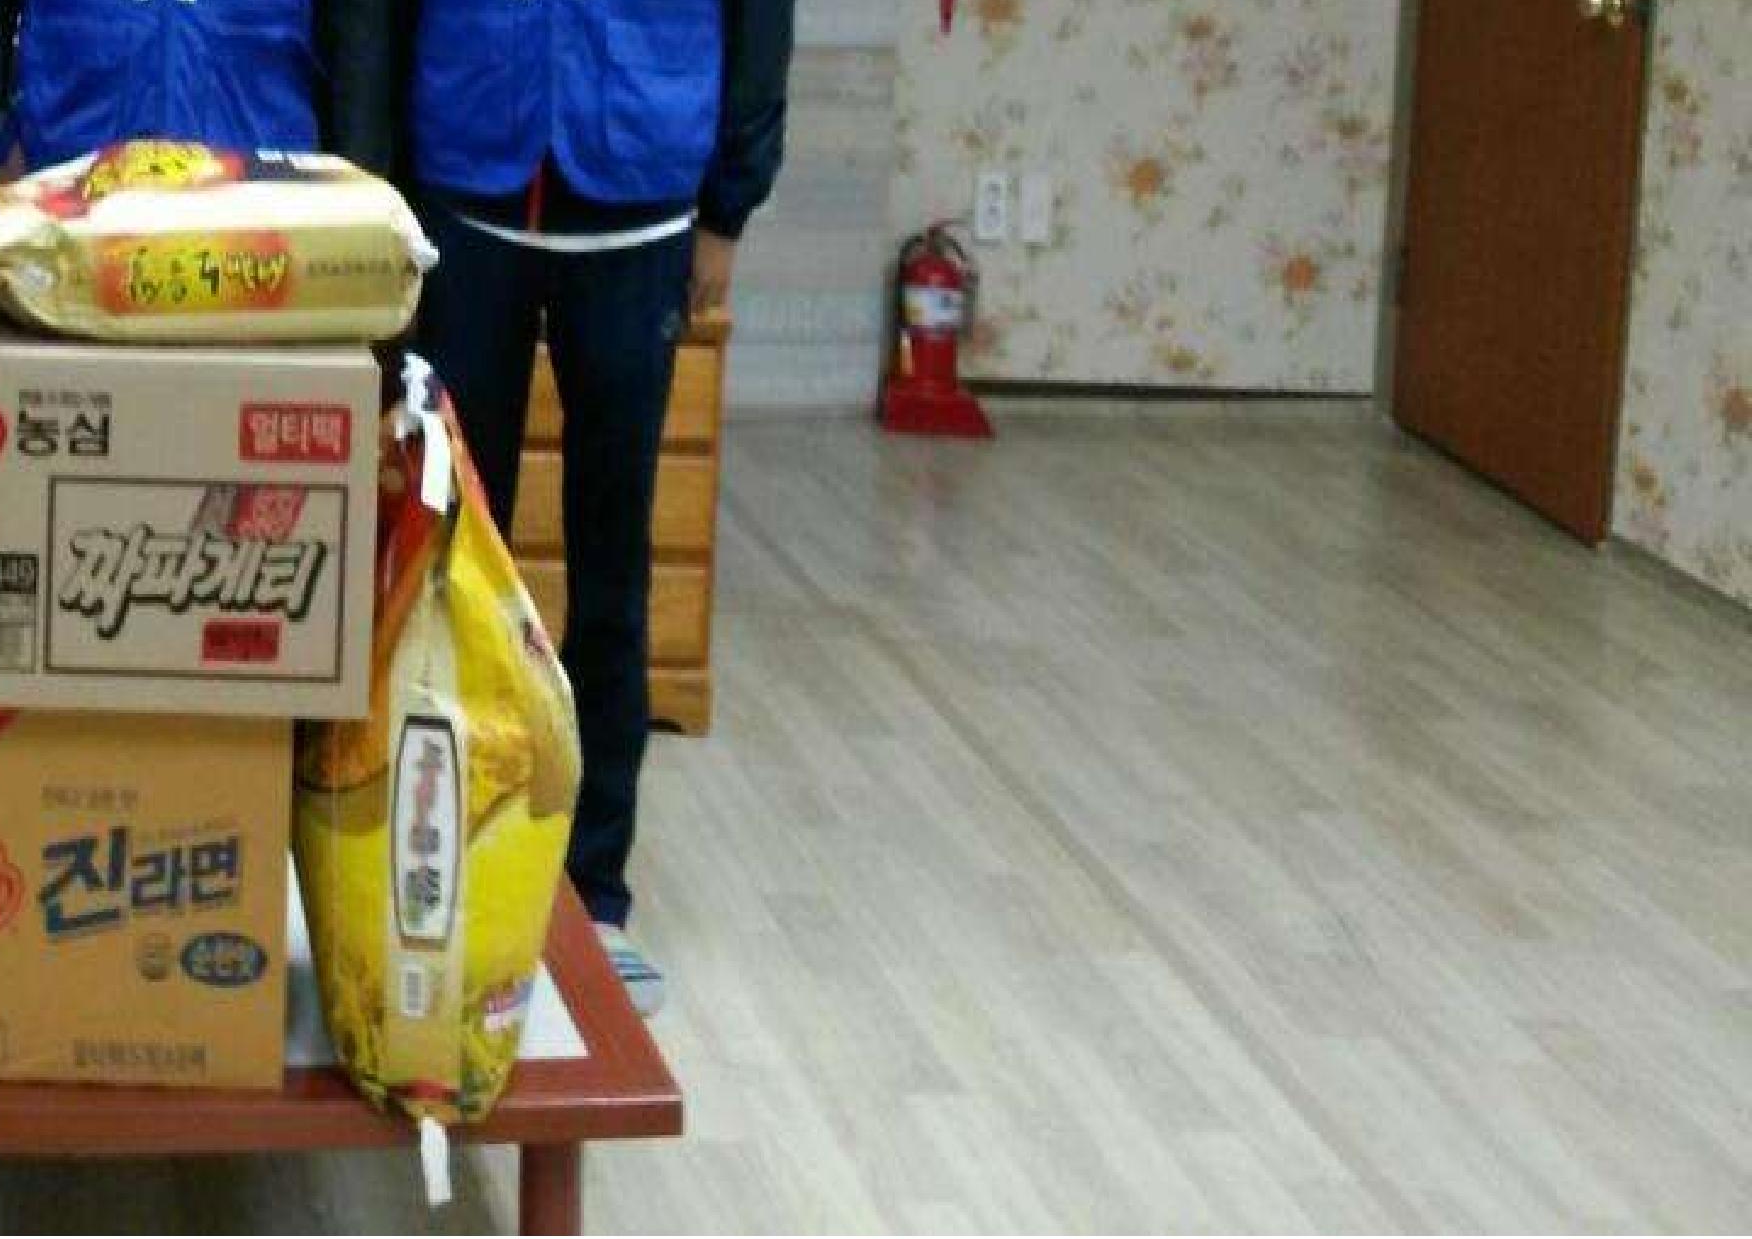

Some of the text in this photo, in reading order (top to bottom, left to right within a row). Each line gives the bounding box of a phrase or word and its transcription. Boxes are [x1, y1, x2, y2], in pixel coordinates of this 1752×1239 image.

[16, 410, 109, 457] 농심
[246, 410, 346, 456] 멀티팩
[58, 523, 328, 640] 짜파게티
[36, 824, 242, 942] 진라면
